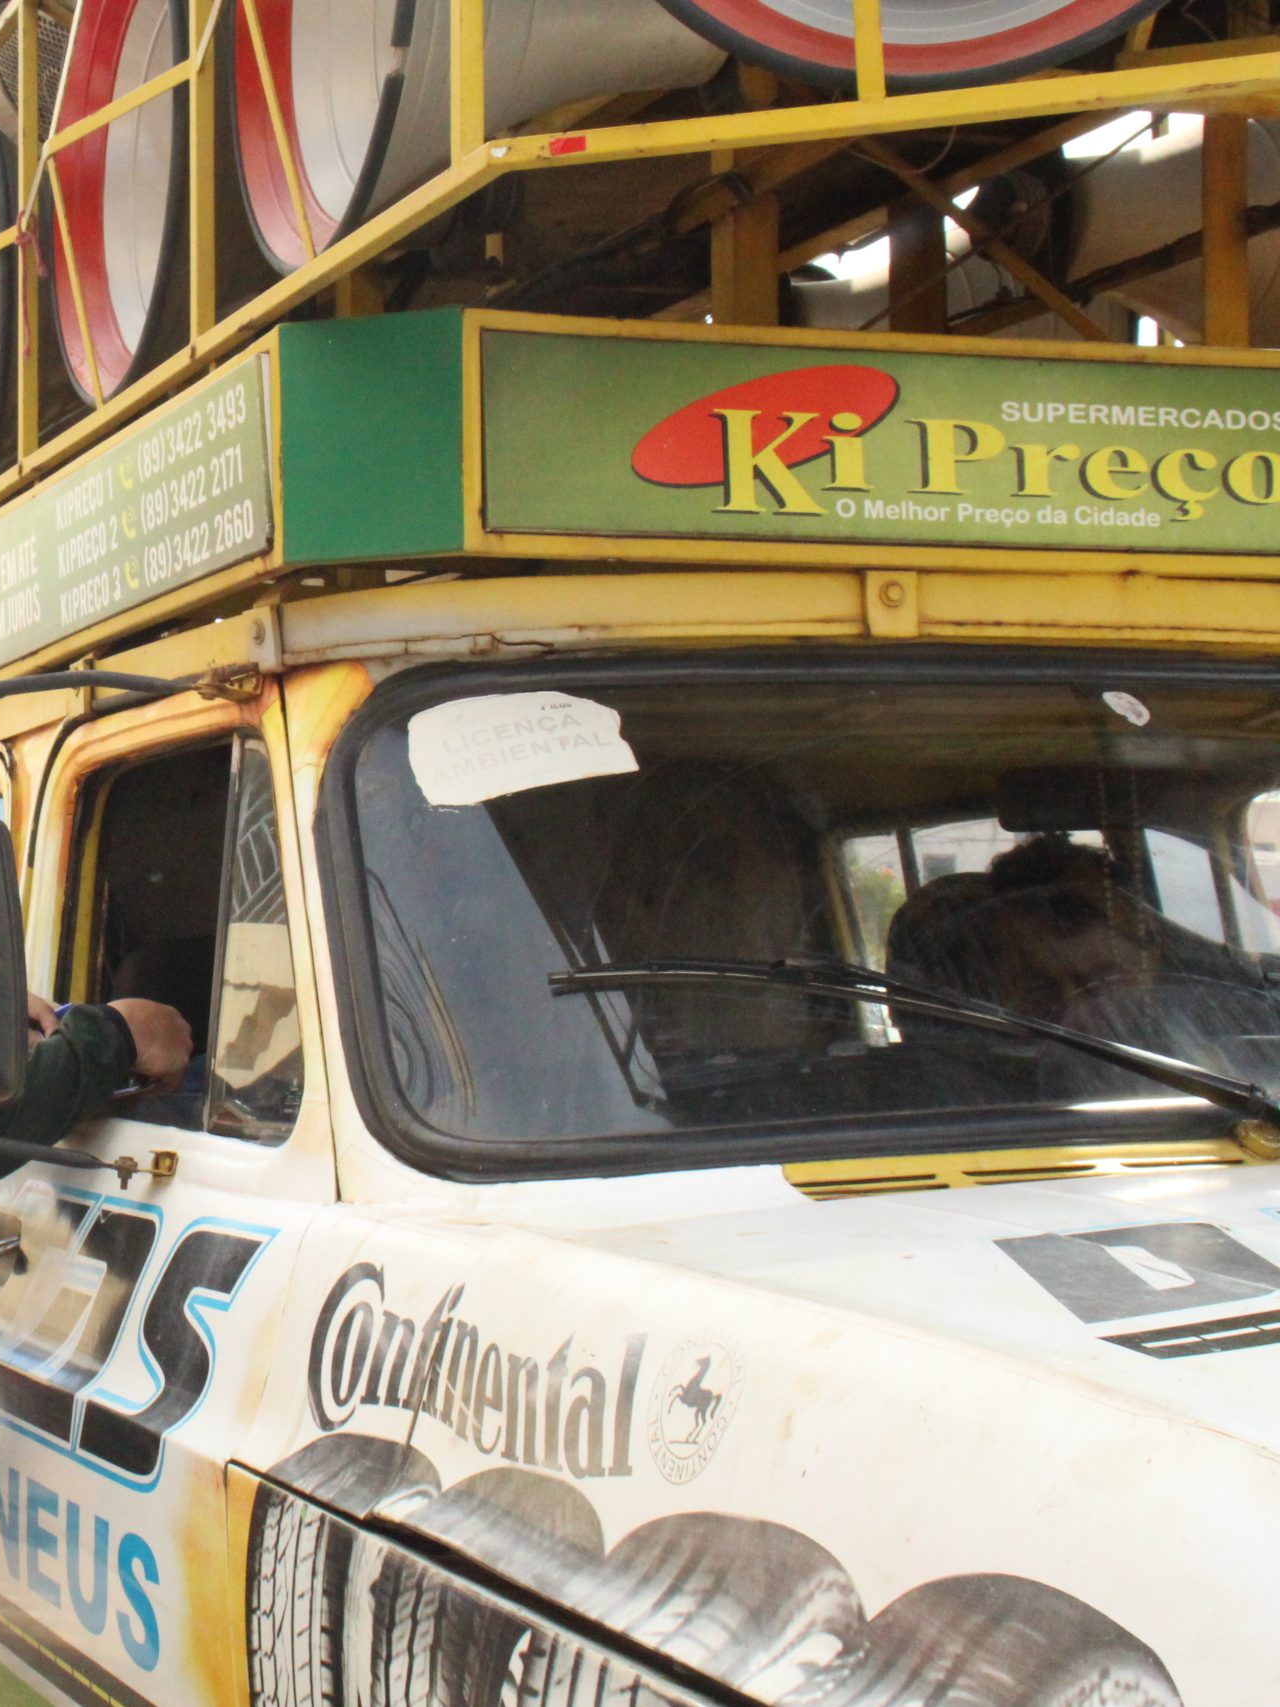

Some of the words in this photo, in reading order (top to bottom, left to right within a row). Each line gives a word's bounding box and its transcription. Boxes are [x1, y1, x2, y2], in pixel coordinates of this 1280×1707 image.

[55, 476, 104, 531] KIPREÇO
[106, 467, 114, 501] 1
[207, 383, 246, 441] 3493
[58, 521, 107, 578] KIPREÇO
[110, 515, 118, 551] 2
[210, 443, 243, 496] 2171
[710, 408, 873, 516] Ki
[906, 418, 1280, 521] Preço
[836, 498, 856, 518] O
[864, 499, 950, 521] Melhor
[957, 503, 1030, 528] Preço
[1037, 505, 1068, 524] da
[1074, 507, 1160, 527] Cidade
[60, 571, 110, 627] KIPREÇO
[112, 565, 121, 602] 3
[214, 499, 254, 555] 2660
[431, 730, 614, 787] AMBIENTAL
[442, 713, 583, 757] LICENÇA
[306, 1261, 648, 1479] Continental
